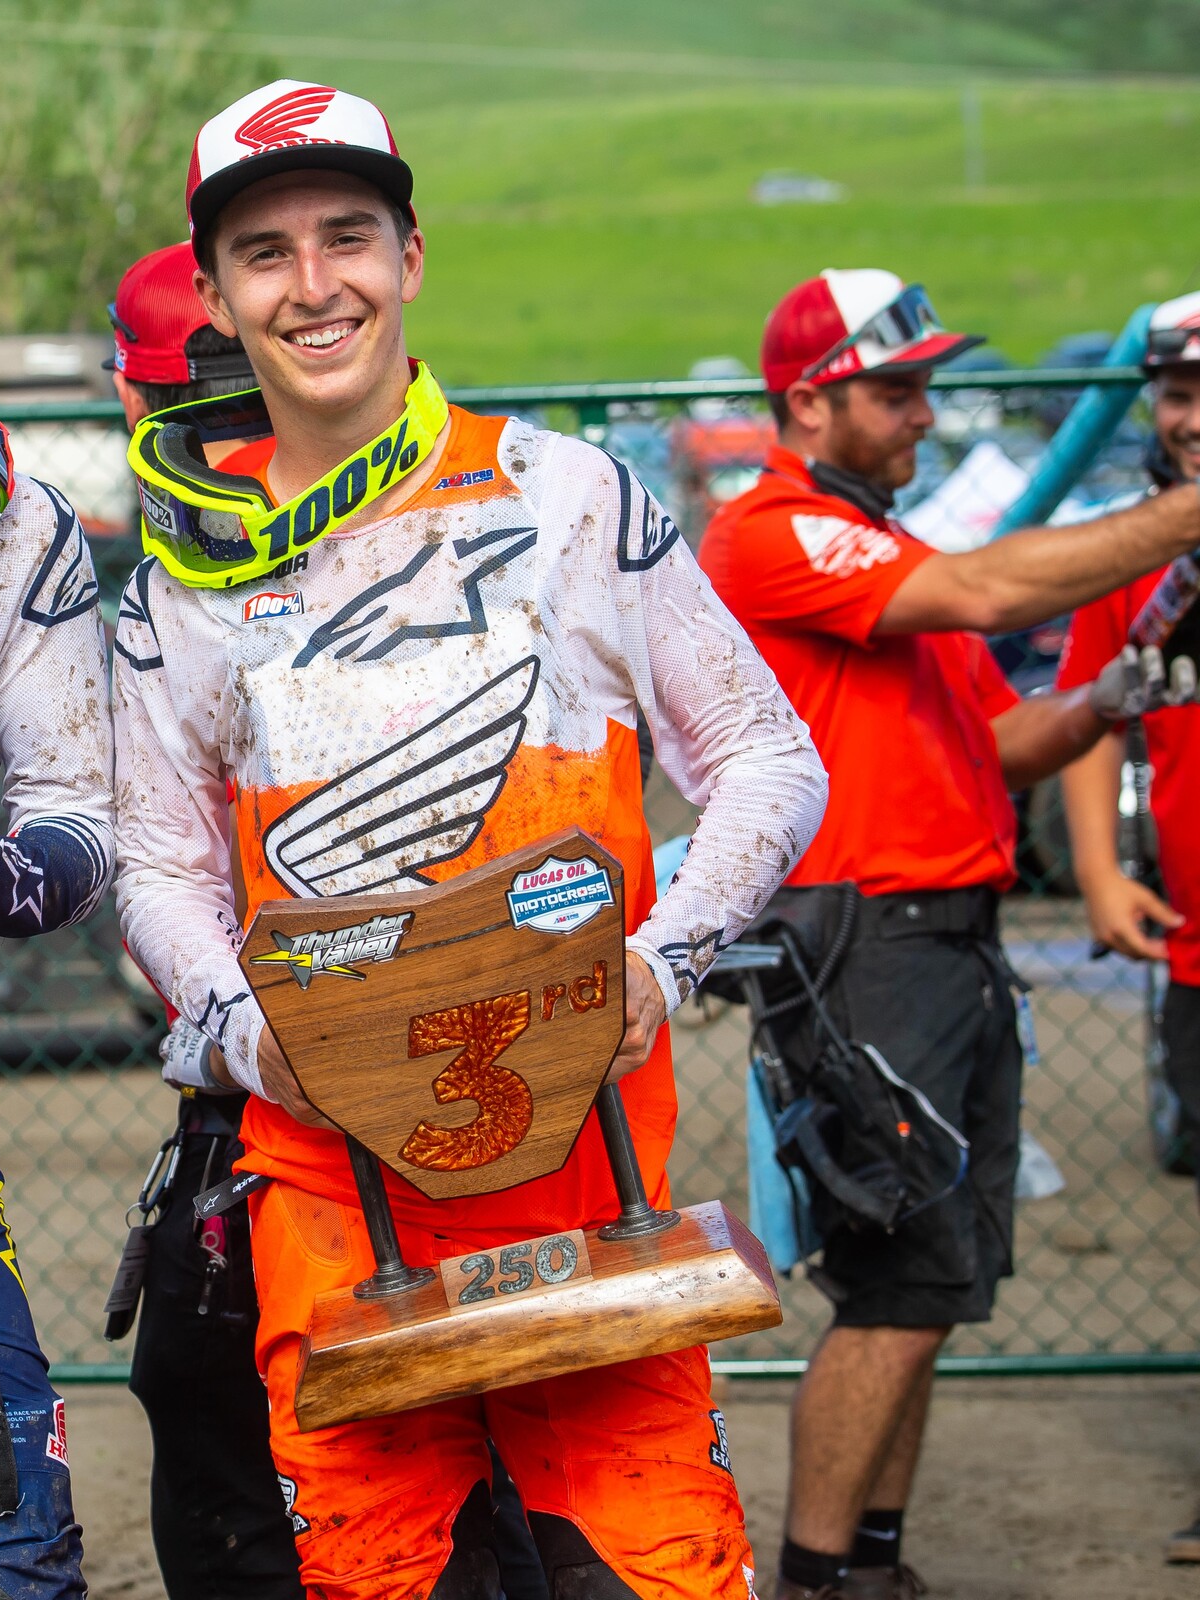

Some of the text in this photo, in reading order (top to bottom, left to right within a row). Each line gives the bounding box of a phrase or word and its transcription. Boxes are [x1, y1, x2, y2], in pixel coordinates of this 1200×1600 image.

[259, 417, 419, 562] 100%
[433, 472, 472, 490] AMA
[141, 492, 170, 527] 100%
[248, 593, 301, 620] 100%
[523, 863, 587, 890] LUCAS OIL
[546, 885, 571, 895] PRO
[514, 881, 607, 914] MOTOCROSS
[516, 891, 608, 918] CHAMPIONSHIP
[290, 912, 411, 957] Thunder
[311, 933, 401, 970] Valley
[458, 1235, 578, 1305] 250
